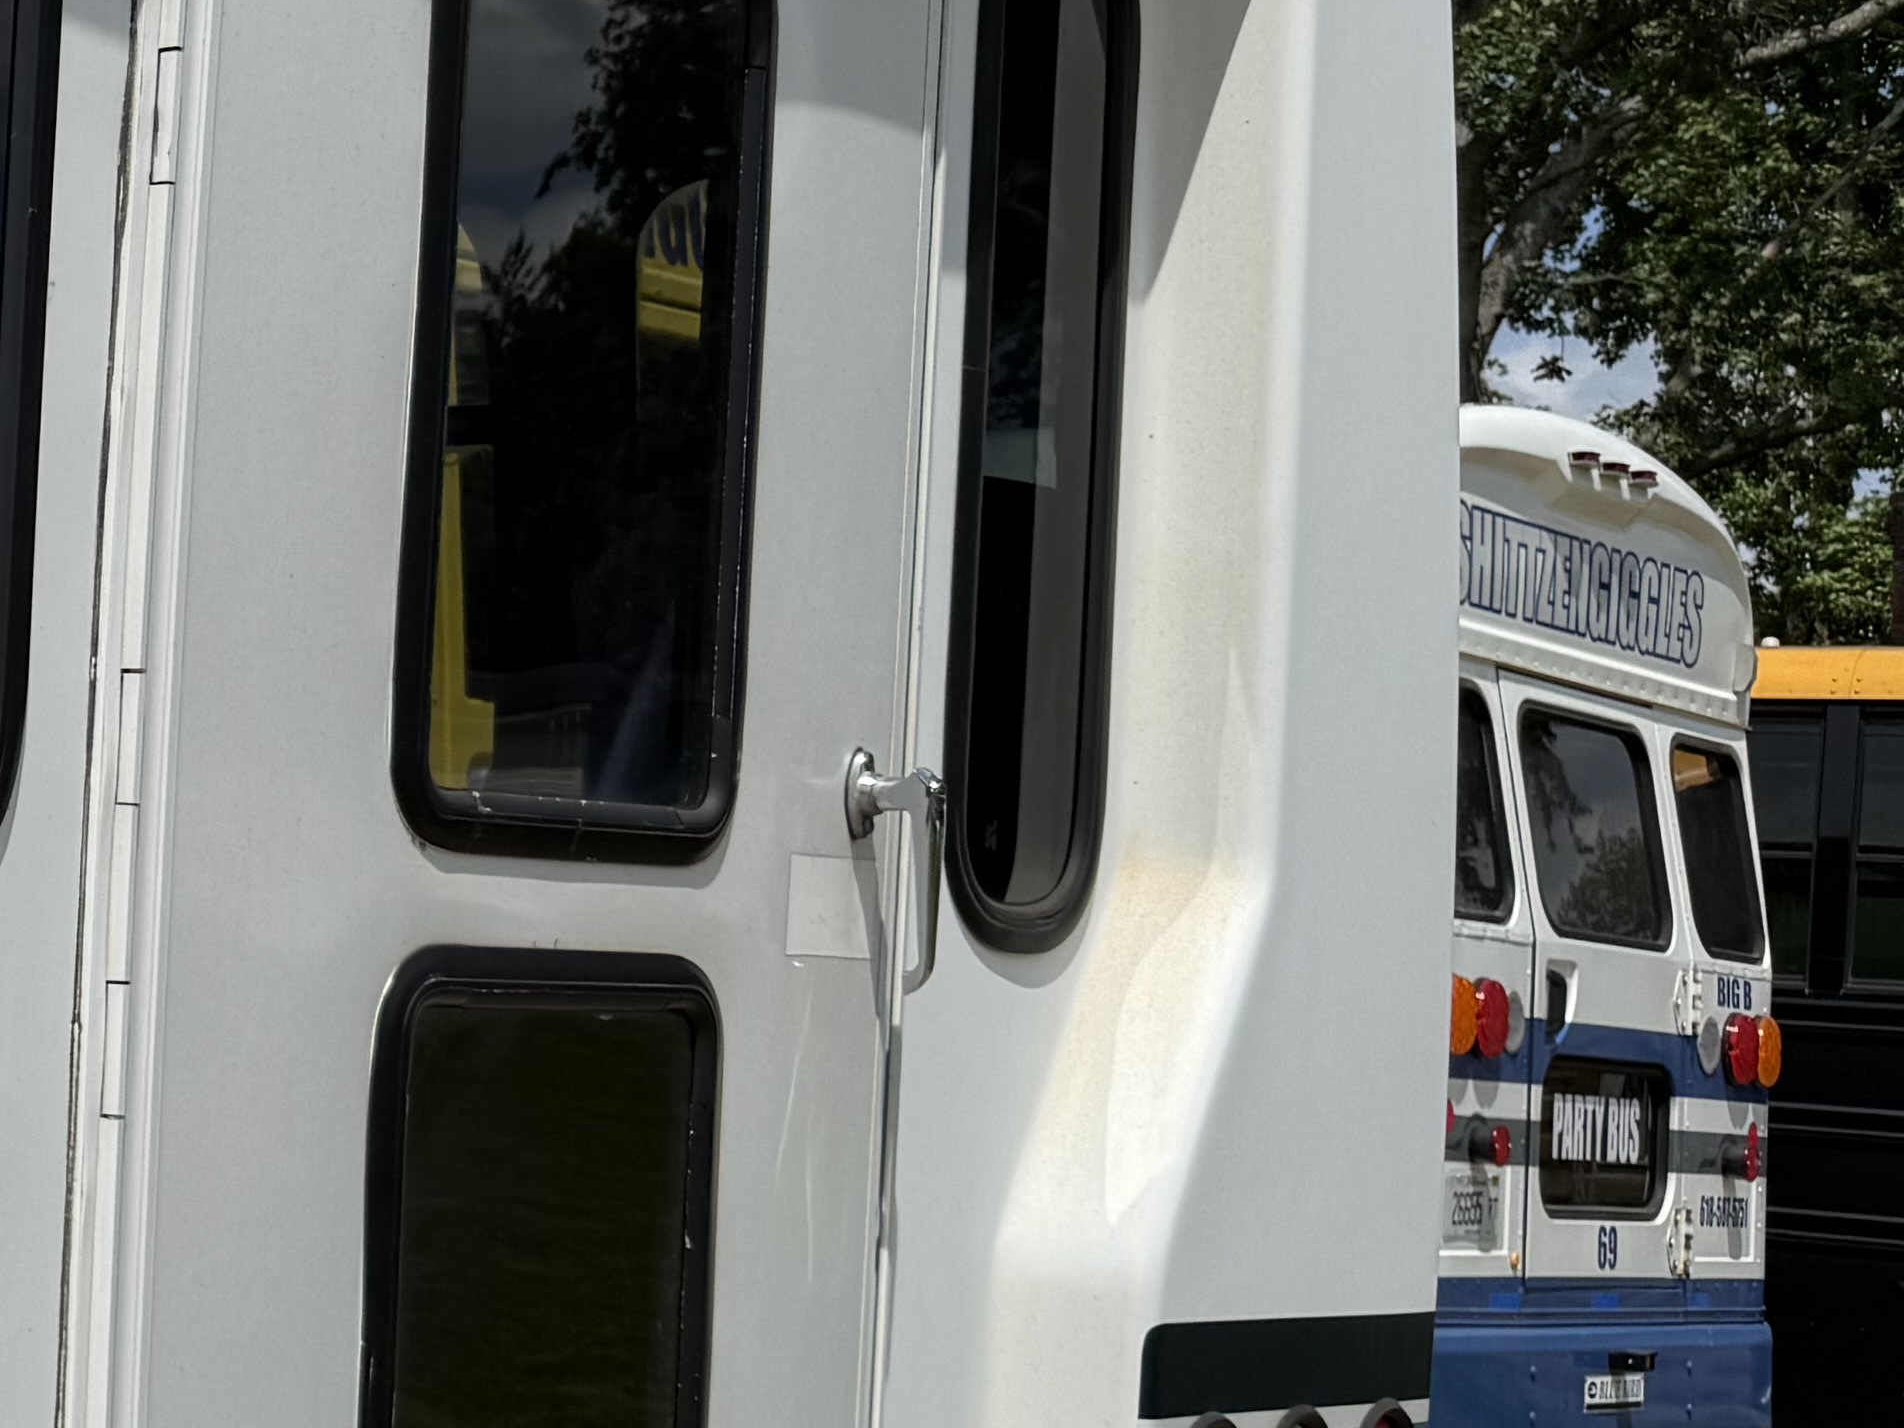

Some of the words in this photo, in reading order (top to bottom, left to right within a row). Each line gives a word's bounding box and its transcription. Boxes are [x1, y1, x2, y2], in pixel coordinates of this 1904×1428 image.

[1717, 976, 1740, 1009] BIG
[1743, 979, 1752, 1011] B
[1552, 1092, 1605, 1162] PARTY
[1606, 1097, 1641, 1165] BUS
[1598, 1215, 1617, 1270] 69
